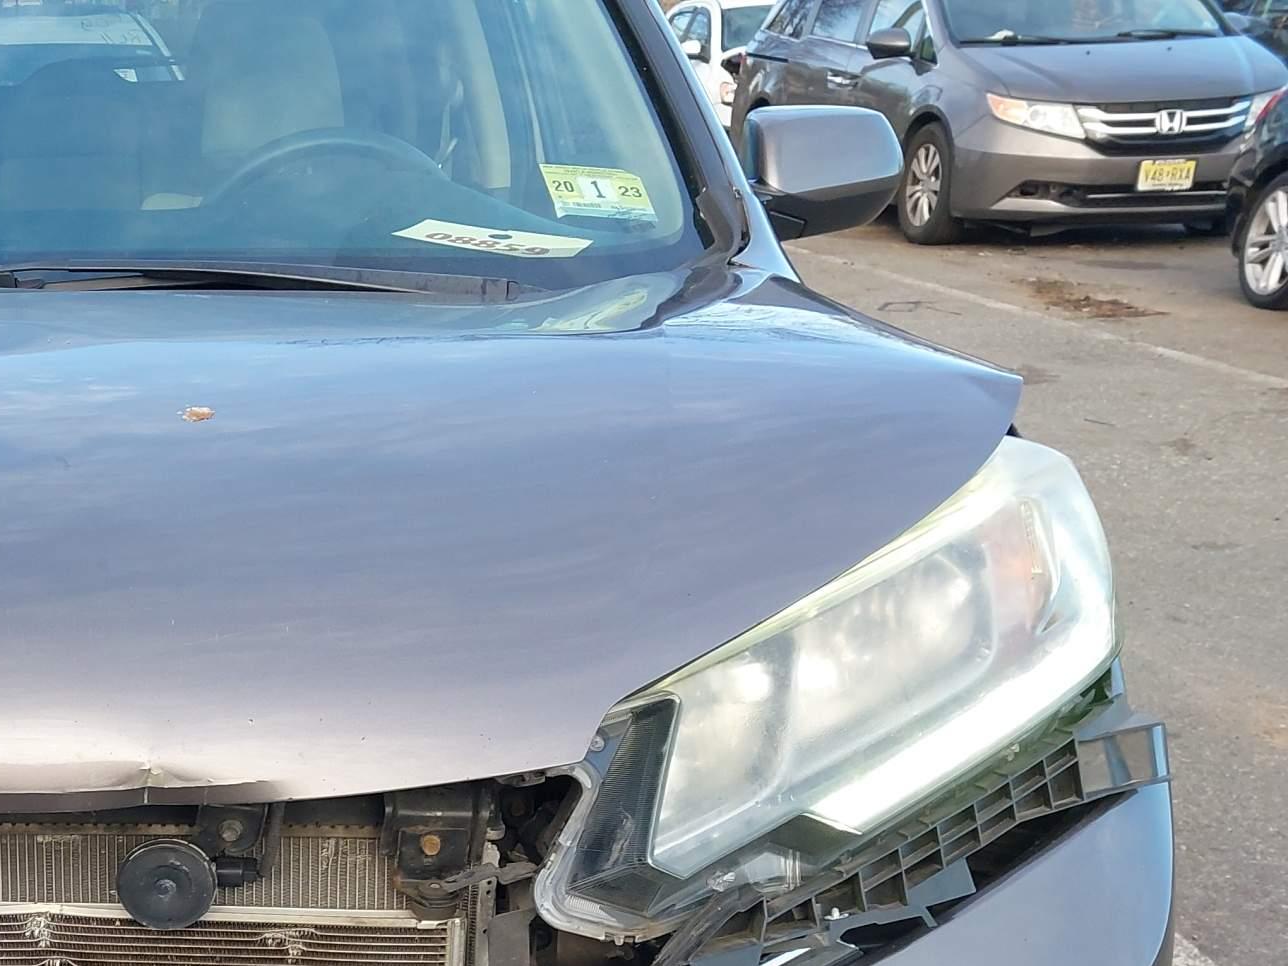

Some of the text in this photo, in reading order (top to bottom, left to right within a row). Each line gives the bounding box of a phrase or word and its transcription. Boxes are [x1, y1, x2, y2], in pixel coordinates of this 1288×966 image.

[552, 180, 643, 199] 20 1 23
[424, 232, 551, 256] 08859
